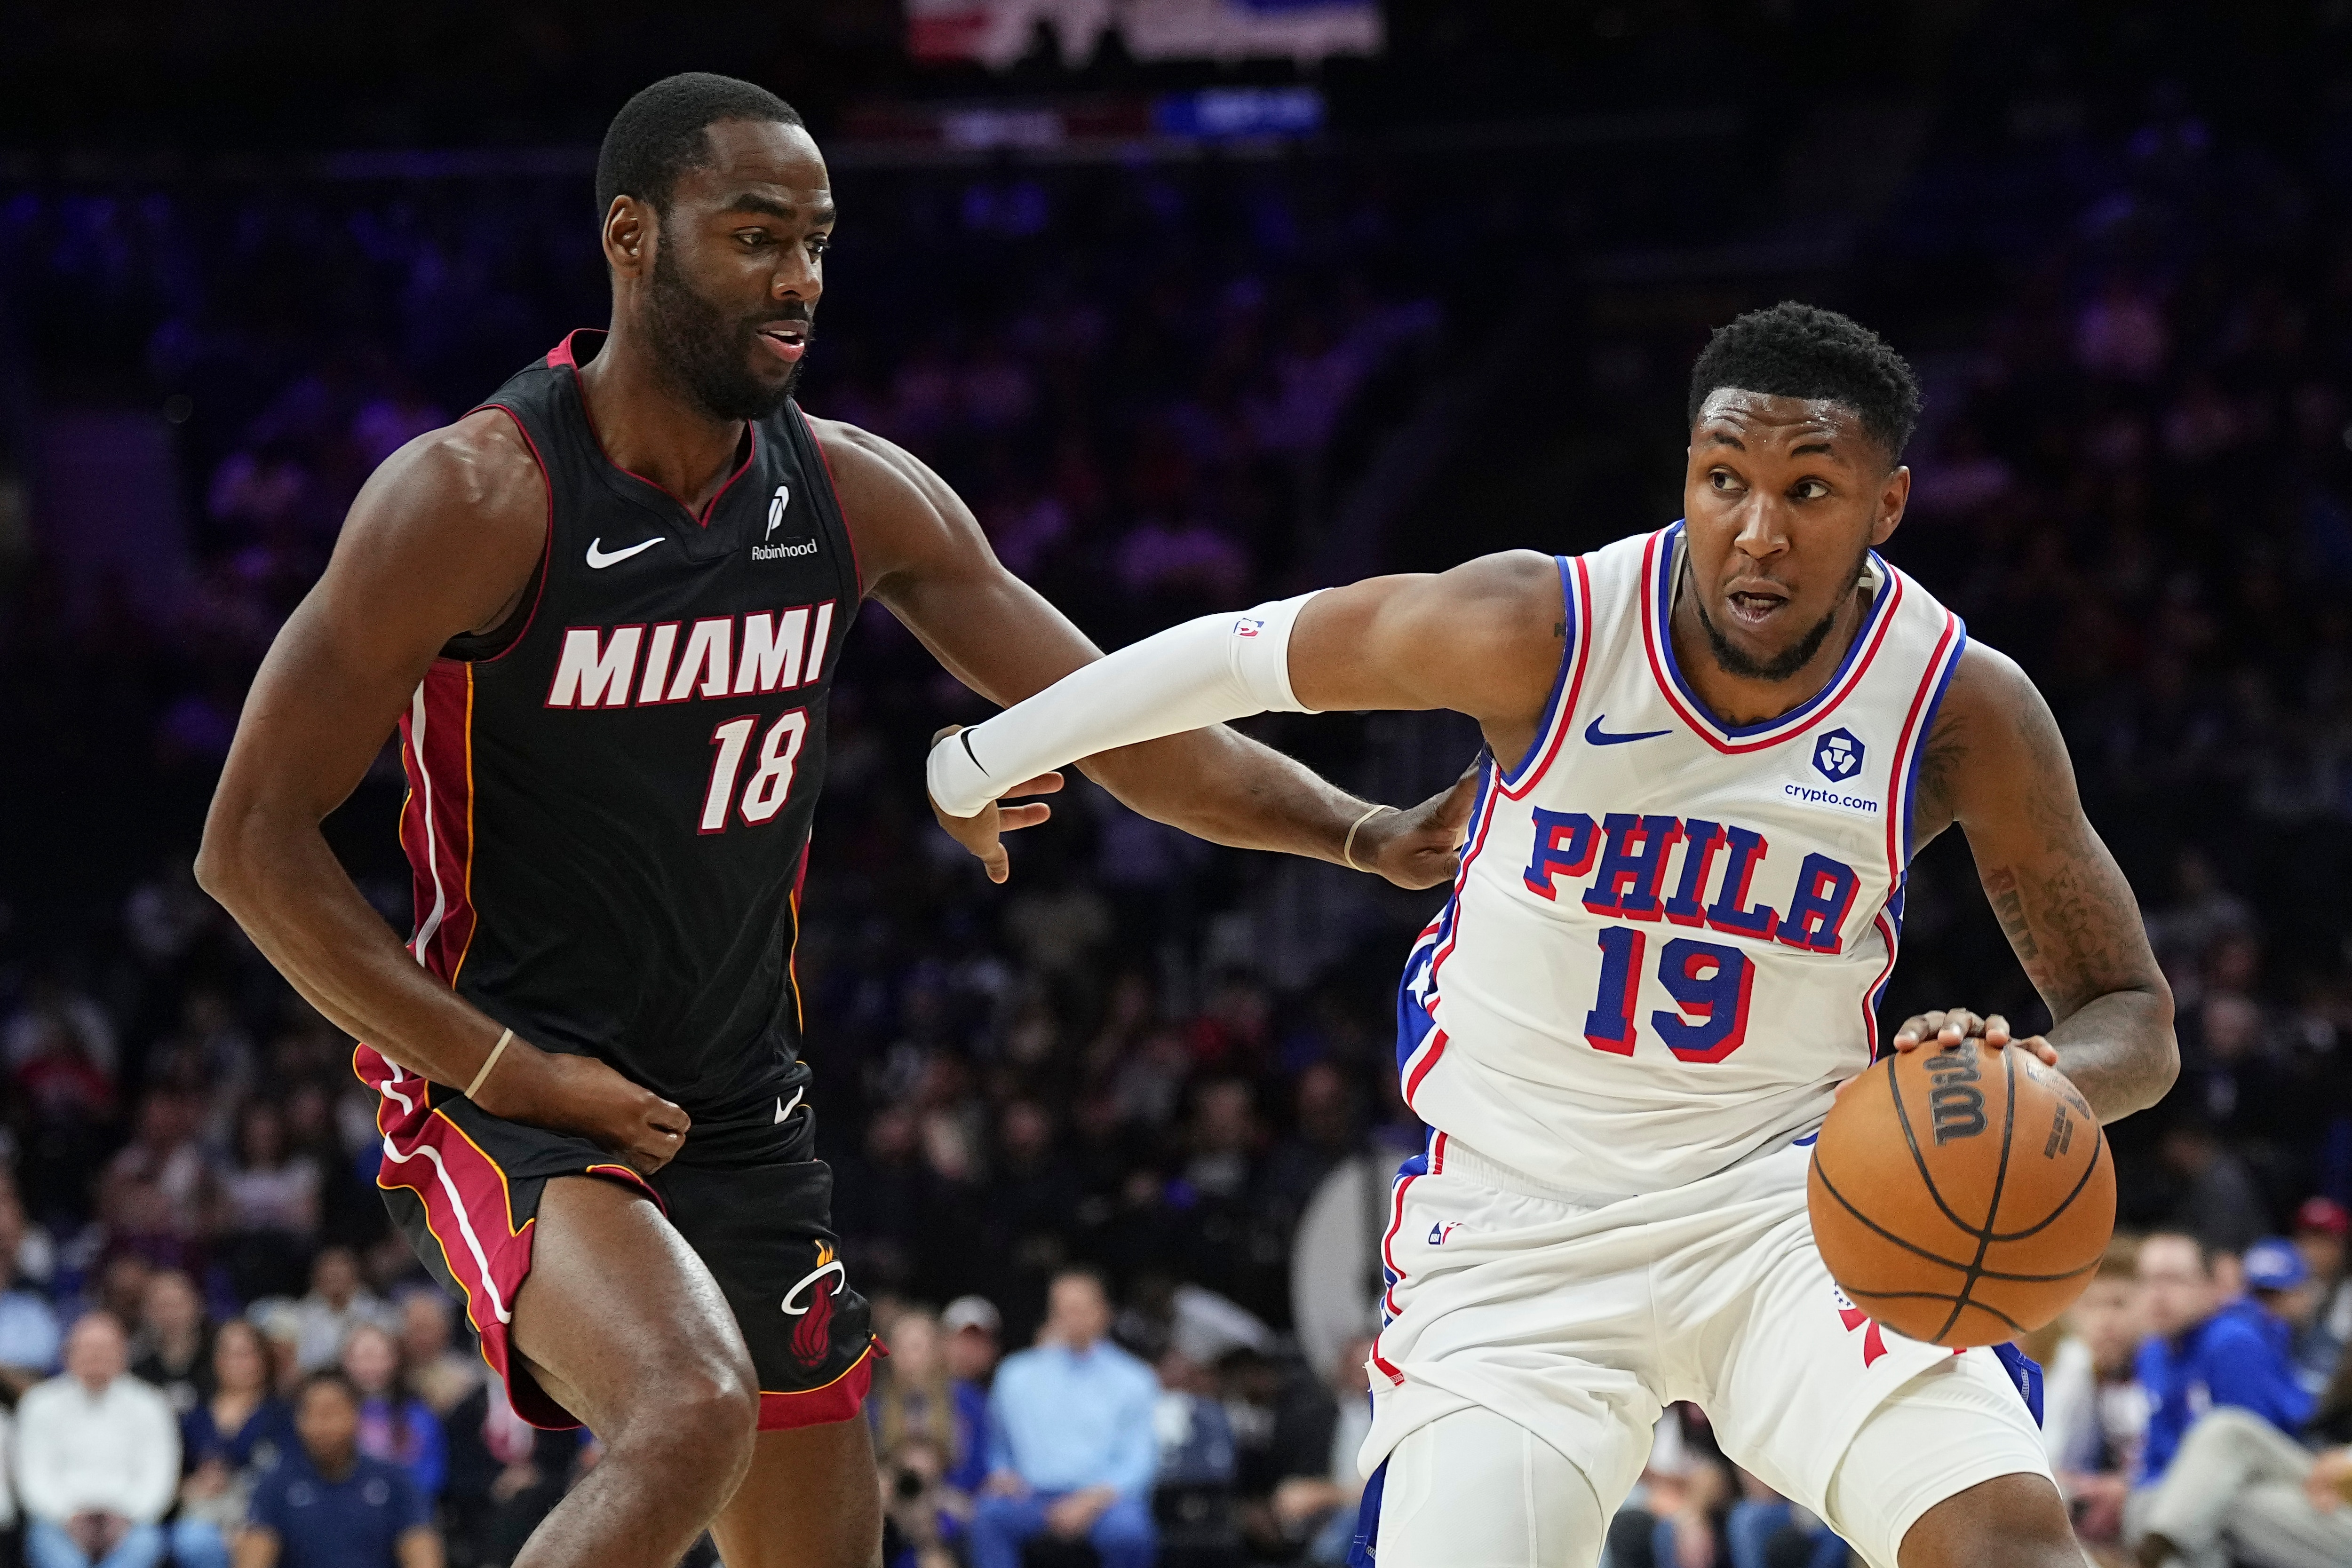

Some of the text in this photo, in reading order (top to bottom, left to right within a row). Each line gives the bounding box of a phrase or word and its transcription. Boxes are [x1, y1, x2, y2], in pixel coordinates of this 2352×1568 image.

[752, 539, 818, 561] Robinhood
[544, 599, 836, 710] MIAMI
[697, 706, 810, 835] 18
[1785, 784, 1877, 812] crypto.com
[1523, 806, 1861, 954] PHILA
[1584, 926, 1756, 1063] 19
